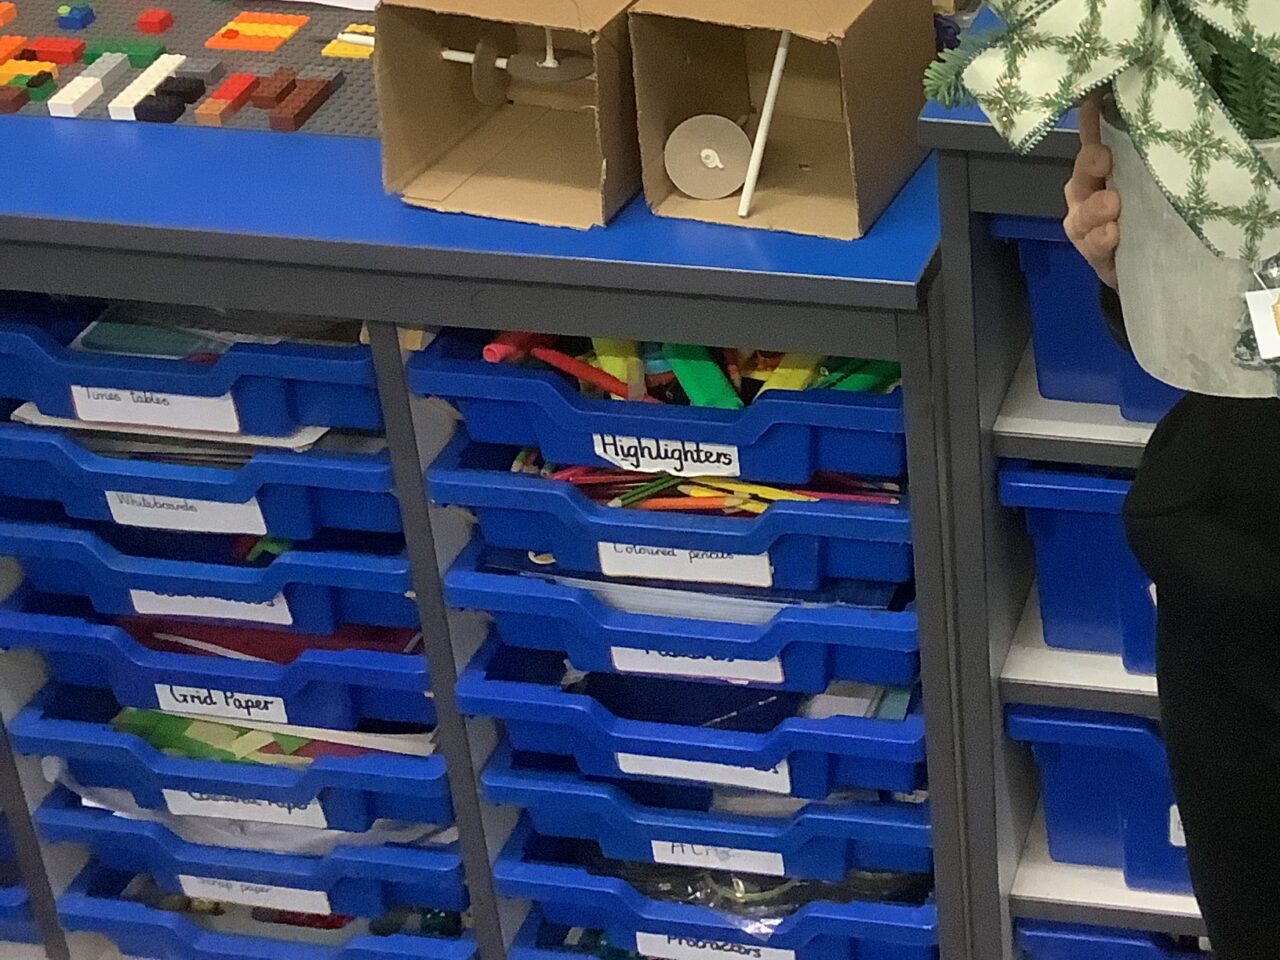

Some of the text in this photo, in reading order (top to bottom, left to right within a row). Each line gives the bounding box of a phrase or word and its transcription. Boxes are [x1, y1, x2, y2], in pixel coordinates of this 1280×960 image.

[130, 391, 170, 406] tables
[601, 433, 733, 472] Highlighters
[116, 492, 198, 512] Whiteboards
[170, 685, 274, 716] Grid Paper
